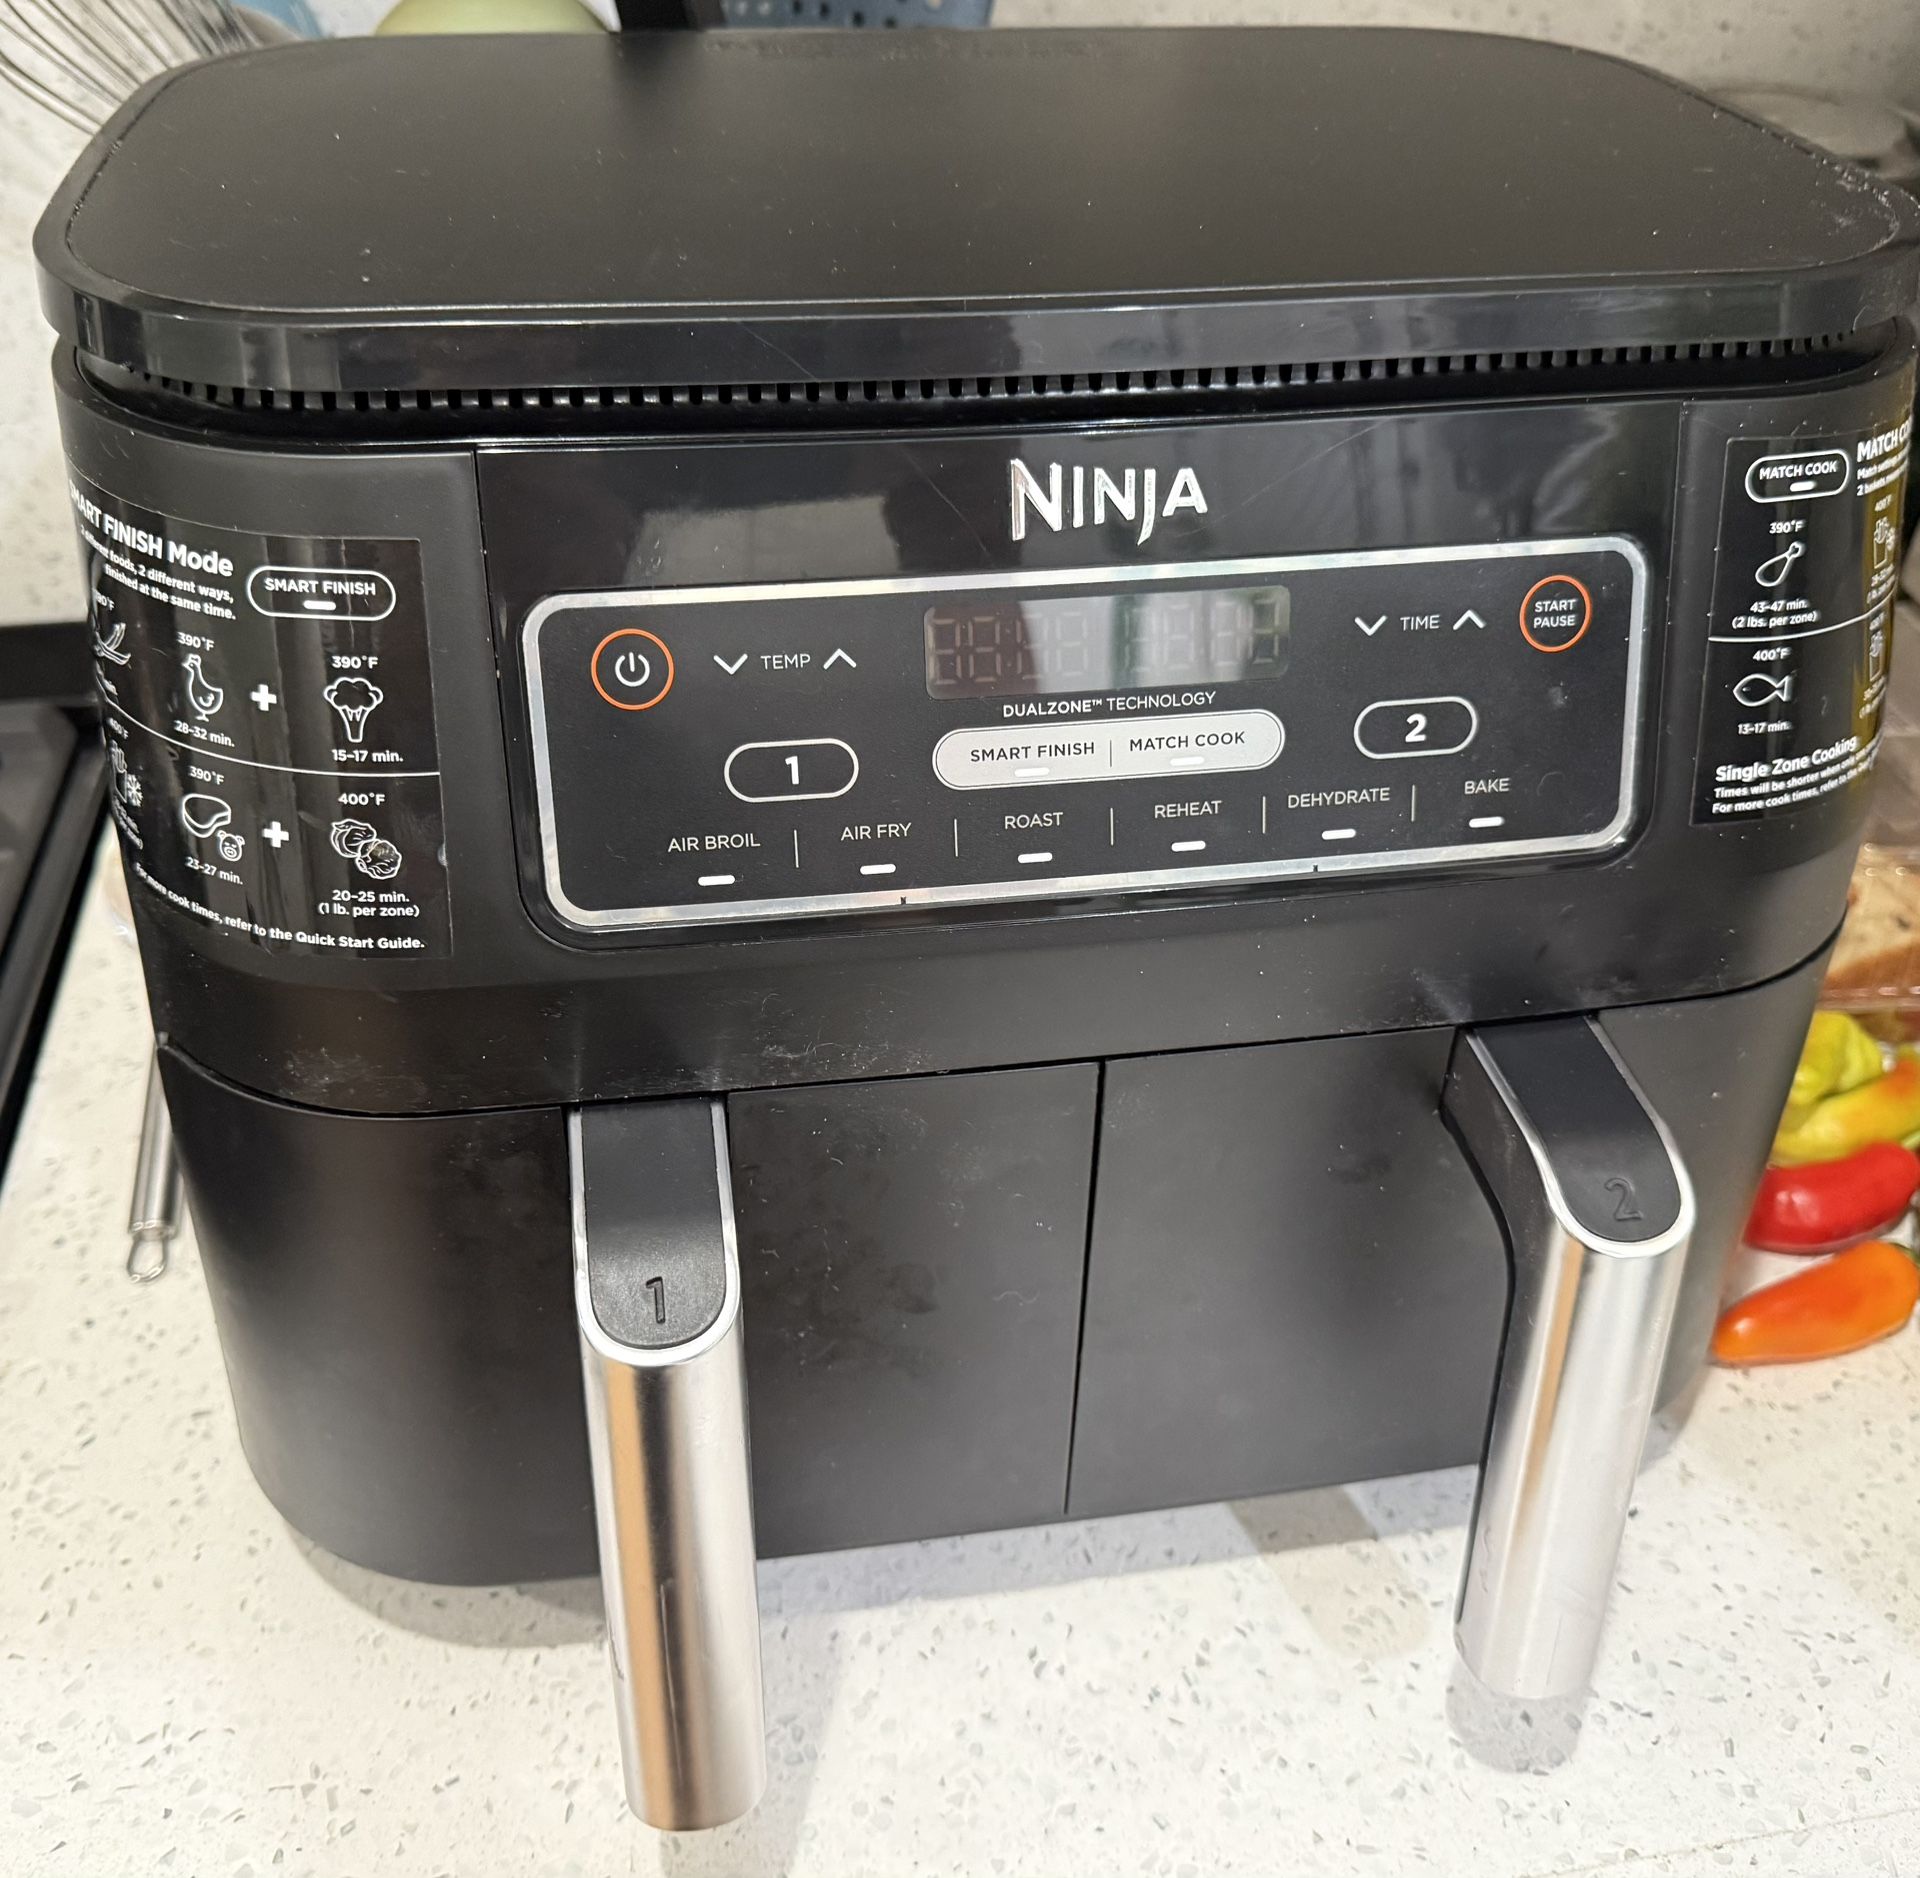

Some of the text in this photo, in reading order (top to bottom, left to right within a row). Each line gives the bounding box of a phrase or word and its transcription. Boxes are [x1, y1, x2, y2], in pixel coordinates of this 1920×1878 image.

[1857, 427, 1899, 462] MATCH
[1759, 460, 1838, 480] MATCH COOK
[1010, 458, 1208, 546] NINJA
[103, 513, 163, 559] FINISH
[167, 540, 234, 577] Mode
[109, 550, 138, 575] foods,
[138, 565, 146, 577] 2
[147, 567, 197, 594] different
[198, 585, 234, 604] ways,
[265, 577, 377, 596] SMART FINISH
[104, 564, 237, 620] finished at the same time.
[1534, 598, 1577, 614] START
[1786, 598, 1809, 610] min.
[1400, 614, 1441, 631] TIME
[1533, 613, 1576, 629] PAUSE
[1732, 611, 1819, 629] (2 lbs. per zone)
[760, 653, 812, 671] TEMP
[1105, 690, 1217, 712] TECHNOLOGY
[1404, 712, 1428, 743] 2
[1767, 720, 1791, 733] min.
[210, 730, 235, 748] min.
[1129, 731, 1246, 752] MATCH COOK
[372, 750, 404, 764] min.
[970, 742, 1096, 763] SMART FINISH
[1715, 760, 1772, 783] Single
[1772, 756, 1813, 776] Zone
[1811, 736, 1859, 765] Cooking
[784, 755, 800, 785] 1
[1464, 777, 1511, 796] BAKE
[1714, 785, 1748, 799] Times
[1750, 782, 1771, 795] will
[1772, 779, 1786, 791] be
[1786, 772, 1819, 789] shorter
[1287, 787, 1391, 809] DEHYDRATE
[1712, 802, 1734, 814] For
[1734, 798, 1765, 812] more
[1765, 794, 1791, 808] cook
[1154, 800, 1222, 819] REHEAT
[1003, 812, 1064, 830] ROAST
[840, 822, 913, 842] AIR FRY
[667, 833, 762, 853] AIR BROIL
[219, 870, 243, 885] min.
[378, 890, 410, 903] min.
[168, 890, 191, 910] cook
[191, 900, 223, 924] times,
[224, 915, 252, 932] refer
[253, 924, 266, 937] to
[269, 927, 293, 942] the
[295, 930, 336, 947] Quick
[338, 935, 374, 948] Start
[376, 935, 425, 949] Guide.
[318, 902, 420, 919] (1 lb. per zone)
[1603, 1176, 1644, 1222] 2
[645, 1275, 666, 1325] 1
